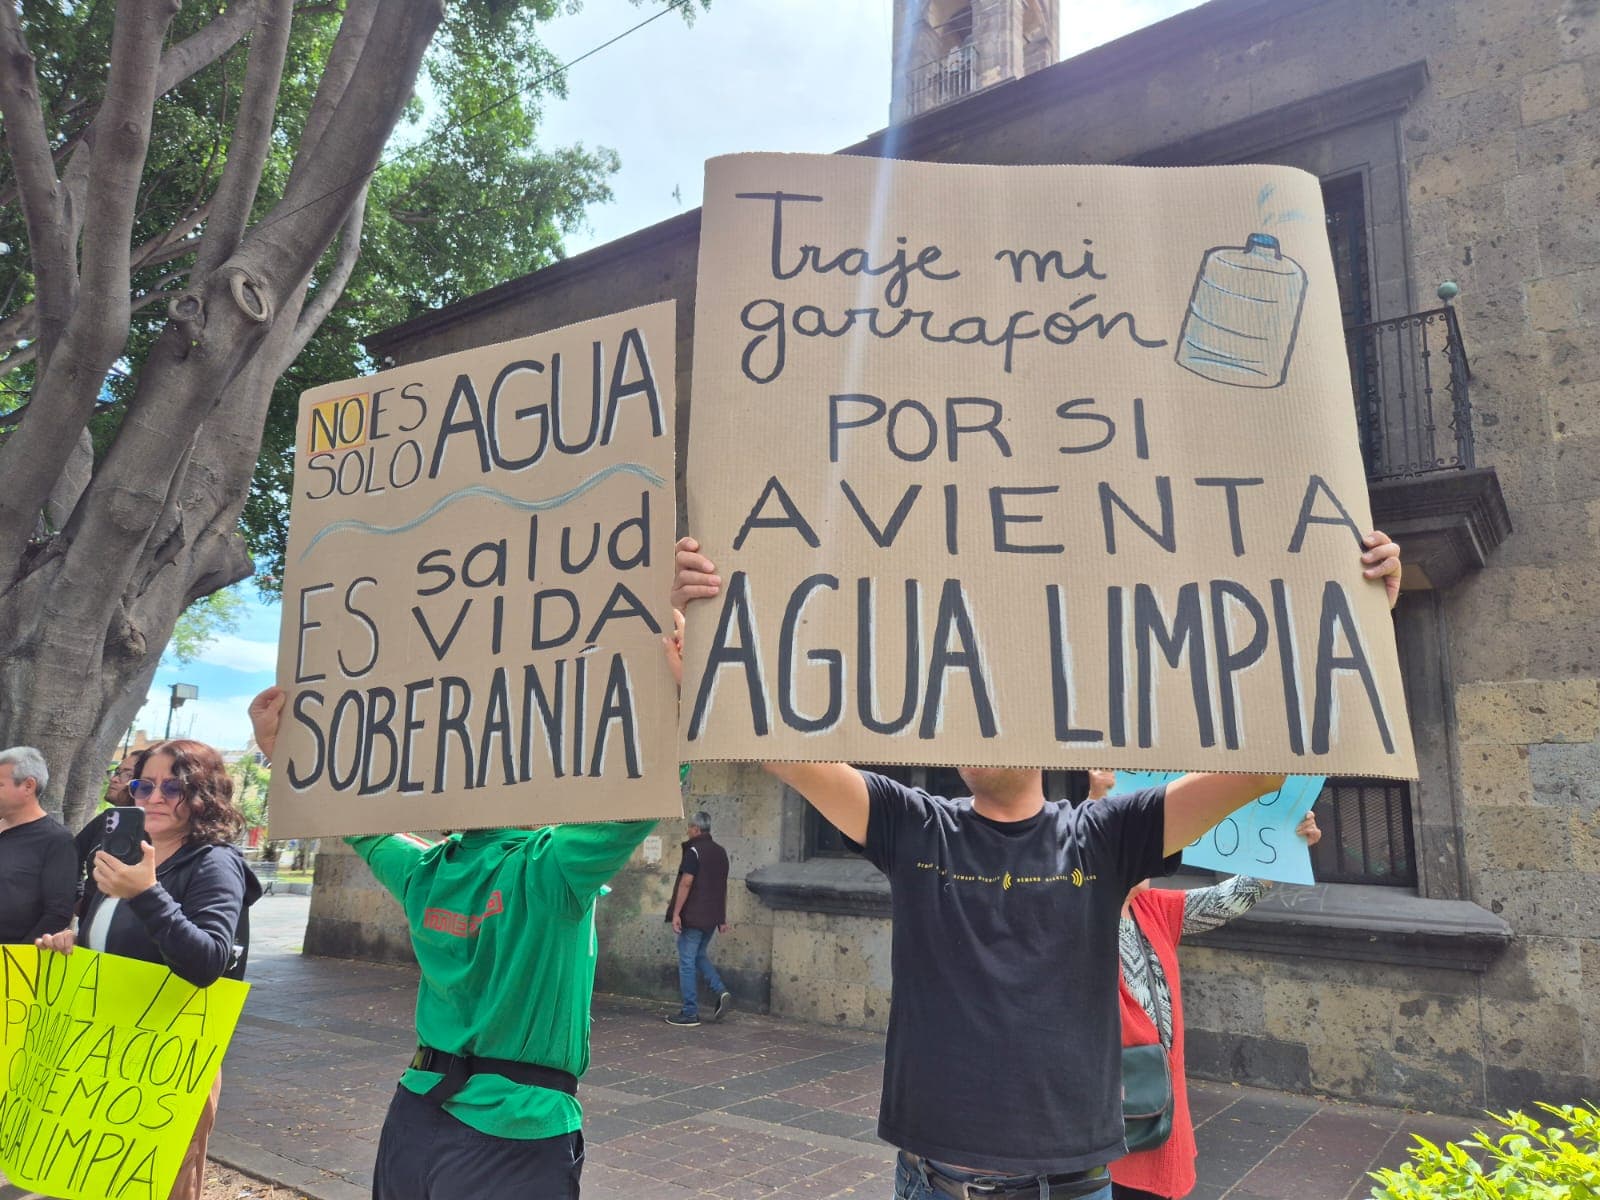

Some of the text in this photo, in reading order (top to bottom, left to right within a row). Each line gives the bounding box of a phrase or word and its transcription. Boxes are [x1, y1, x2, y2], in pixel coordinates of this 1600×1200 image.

[735, 191, 1107, 304] Traje mi
[740, 293, 1168, 385] garrafón
[310, 382, 428, 451] NO ES
[428, 327, 664, 480] AGUA
[828, 394, 1150, 462] POR SI
[306, 440, 422, 499] SOLO
[734, 475, 1368, 556] AVIENTA
[417, 490, 650, 596] salud
[295, 577, 379, 684] ES
[412, 582, 662, 662] VIDA
[687, 570, 1396, 755] AGUA LIMPIA
[287, 642, 643, 796] SOBERANÍA
[2, 945, 208, 1037] NO A LA
[20, 1118, 158, 1200] LIMPIA
